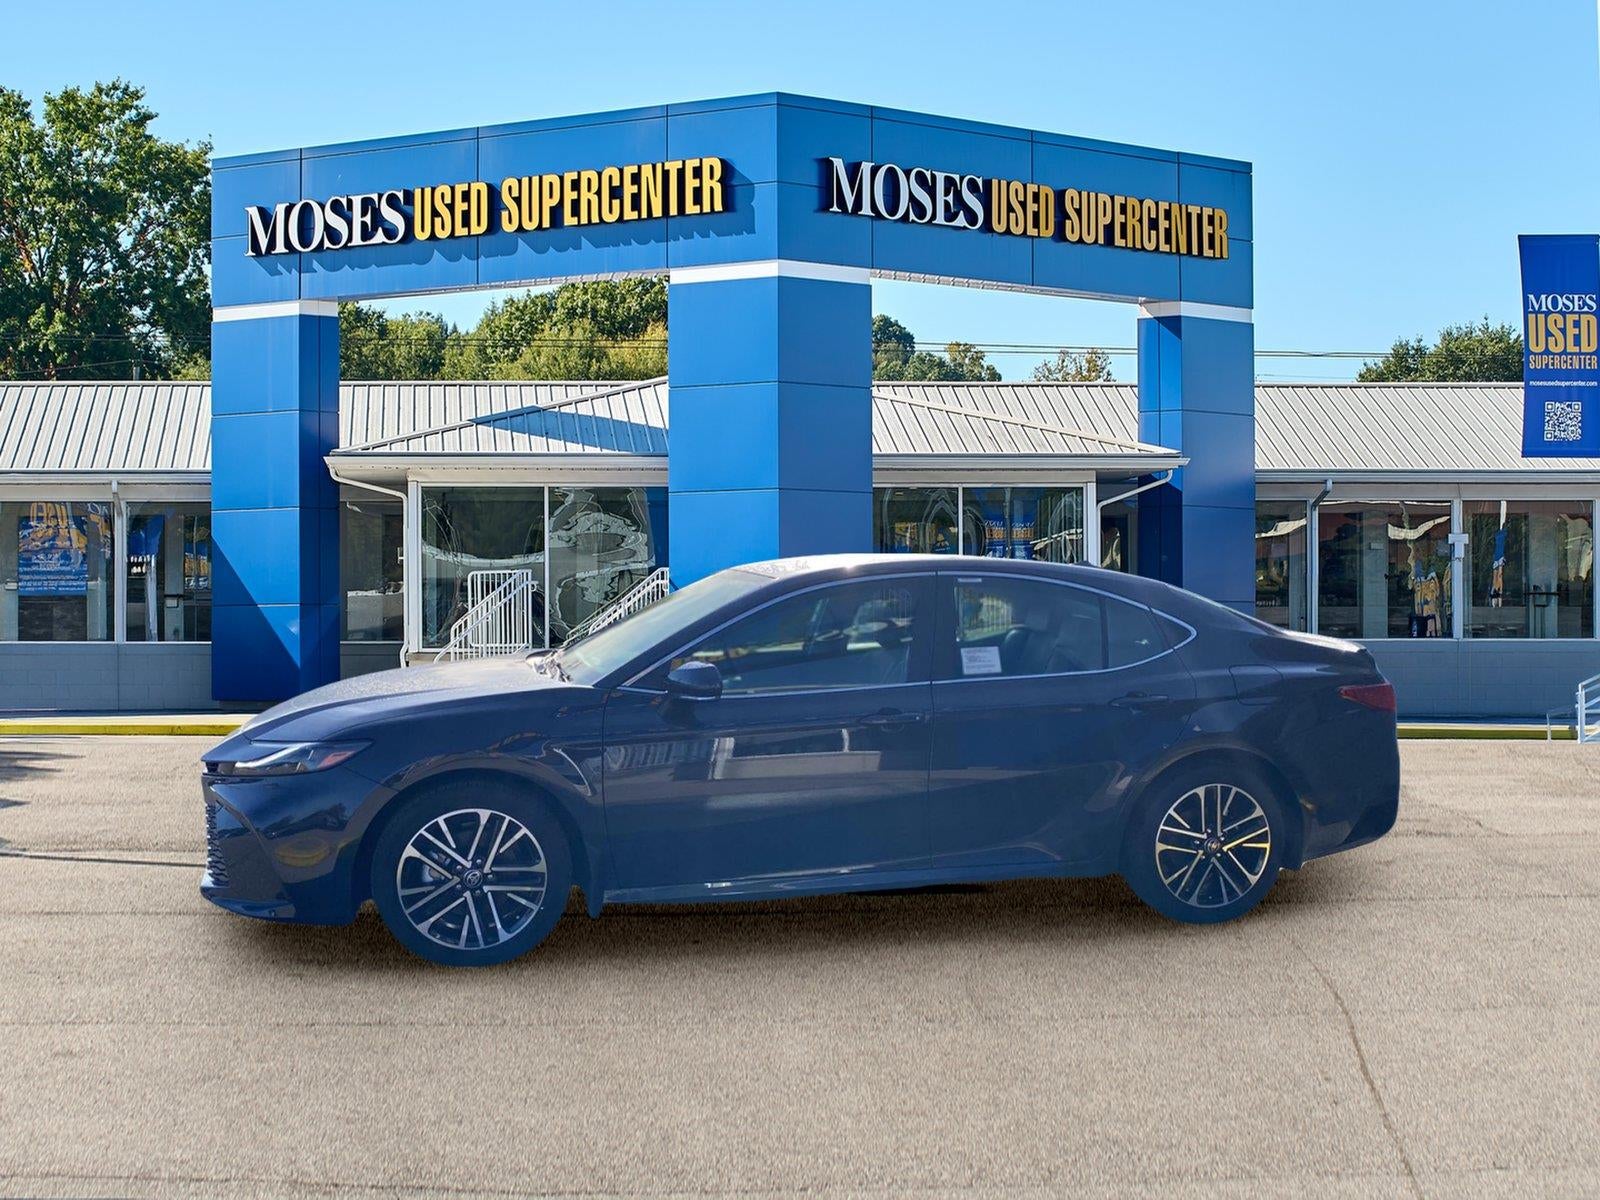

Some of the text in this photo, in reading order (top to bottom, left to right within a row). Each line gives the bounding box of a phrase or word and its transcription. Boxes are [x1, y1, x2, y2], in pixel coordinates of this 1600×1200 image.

[244, 157, 724, 257] MOSES USED SUPERCENTER
[828, 157, 1230, 259] MOSES USED SUPERCENTER
[1527, 294, 1597, 312] MOSES
[1528, 313, 1598, 353] USED
[1529, 355, 1598, 370] SUPERCENTER
